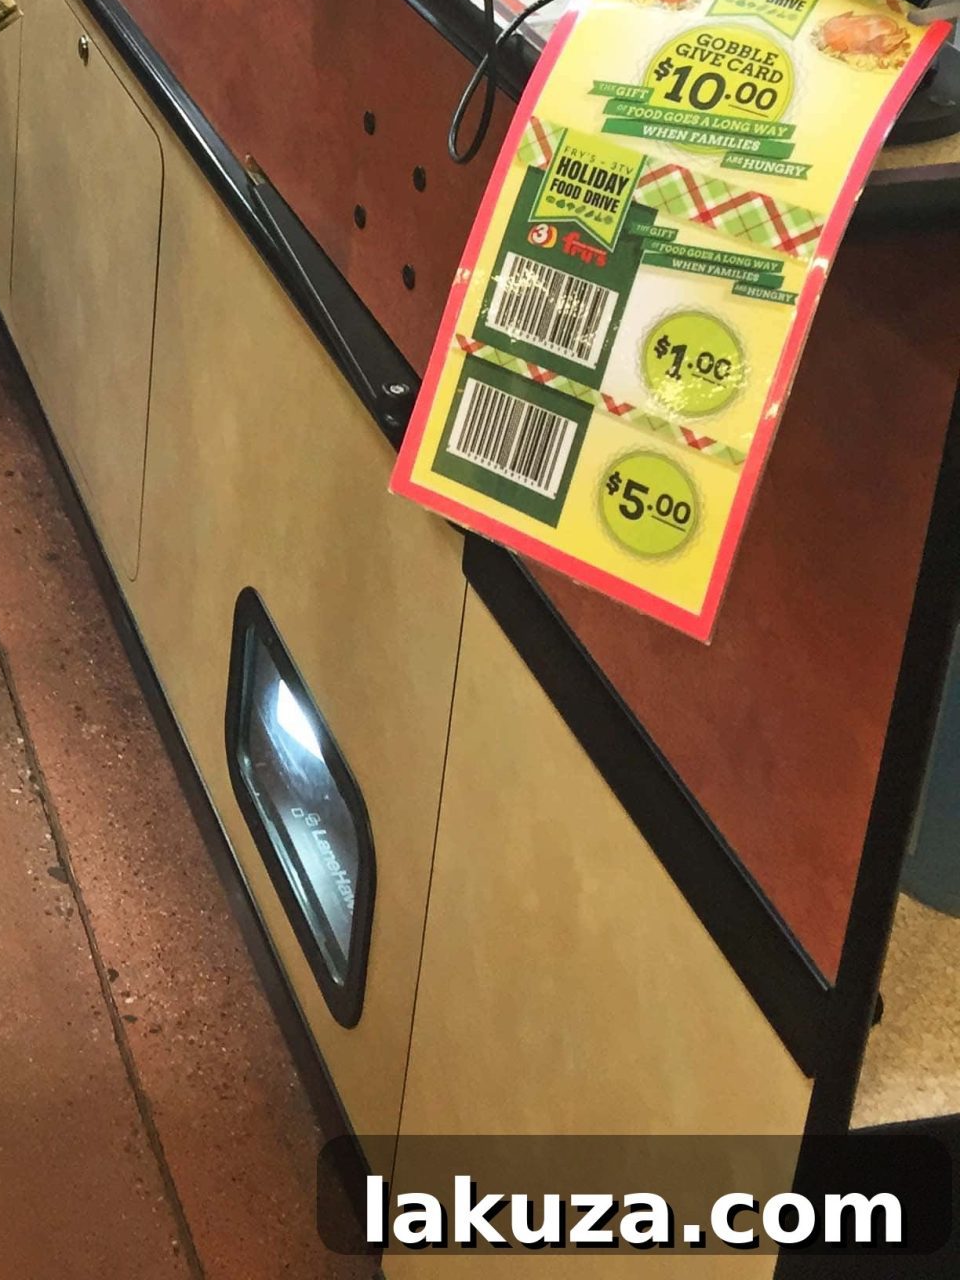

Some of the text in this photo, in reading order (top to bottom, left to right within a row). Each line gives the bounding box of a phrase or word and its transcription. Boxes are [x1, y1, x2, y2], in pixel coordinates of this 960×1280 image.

[675, 43, 784, 85] GIVE CARD
[696, 33, 779, 67] GOBBLE
[615, 86, 650, 100] GIFT
[653, 57, 778, 111] $10.00
[626, 105, 663, 120] FOOD
[663, 111, 700, 126] GOES
[700, 117, 711, 128] A
[712, 118, 750, 134] LONG
[753, 123, 789, 138] WAY
[642, 124, 761, 152] WHEN FAMILIES
[563, 145, 596, 163] FRY'S
[743, 159, 806, 177] HUNGRY
[556, 156, 630, 196] HOLIDAY
[549, 178, 620, 214] FOOD DRIVE
[533, 223, 607, 267] 3 fry's
[649, 227, 676, 239] GIFT
[658, 243, 685, 255] FOOD
[686, 248, 713, 260] GOES
[713, 253, 721, 262] A
[722, 255, 752, 267] LONG
[752, 259, 779, 270] WAY
[672, 258, 760, 281] WHEN FAMILIES
[746, 287, 793, 302] HUNGRY
[653, 334, 731, 381] $1.00
[606, 471, 691, 524] $5.00
